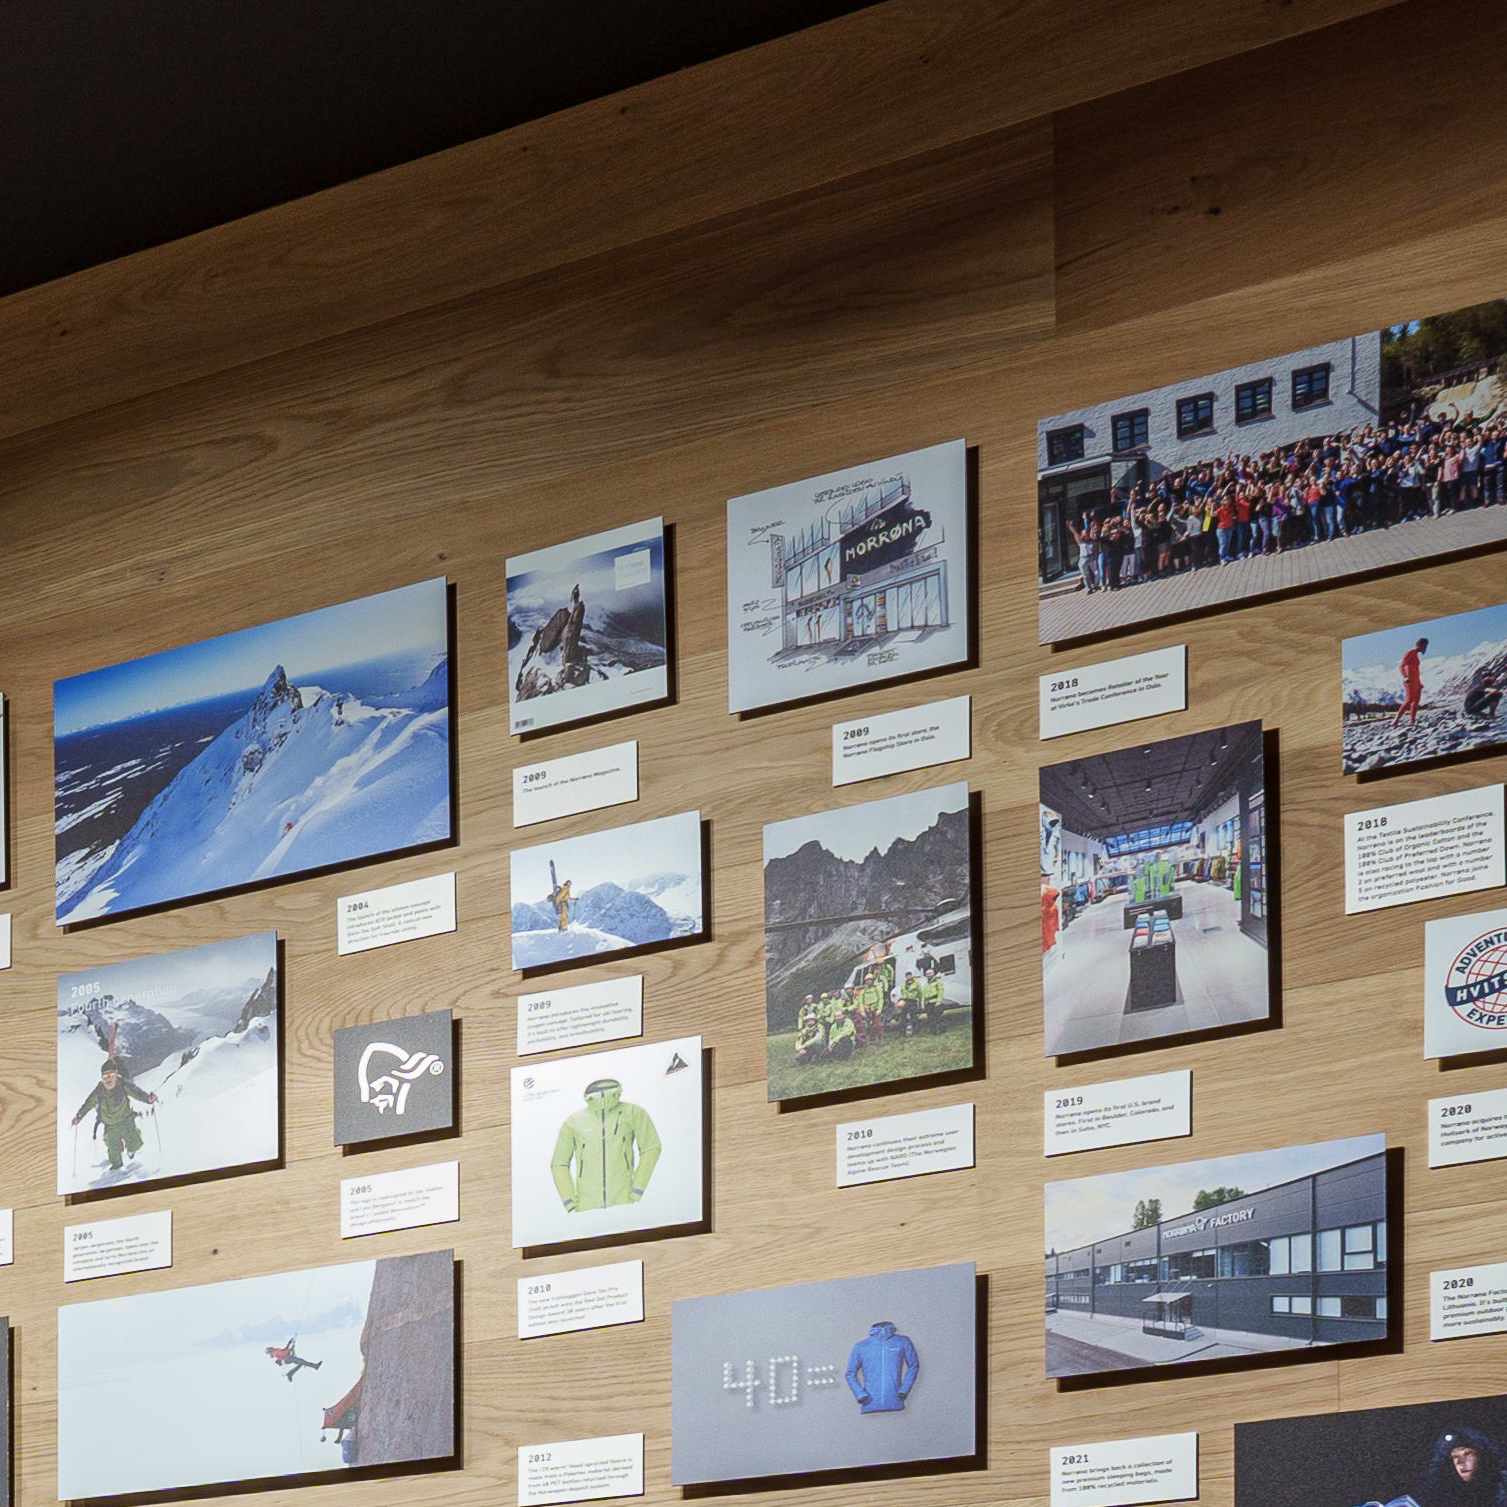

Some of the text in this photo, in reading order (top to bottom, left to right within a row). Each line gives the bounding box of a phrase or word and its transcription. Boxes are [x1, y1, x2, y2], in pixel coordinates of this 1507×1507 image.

[1050, 677, 1078, 692] 2018
[842, 725, 869, 741] 2009
[522, 770, 546, 784] 2009
[1356, 815, 1387, 831] 2018
[71, 982, 100, 998] 2005
[527, 999, 552, 1012] 2009
[1055, 1095, 1083, 1109] 2019
[1440, 1103, 1471, 1118] 2020
[846, 1128, 873, 1141] 2010
[1210, 1208, 1255, 1228] FACTORY
[527, 1283, 551, 1295] 2010
[1442, 1276, 1473, 1291] 2020
[527, 1452, 552, 1464] 2012
[1061, 1453, 1089, 1466] 2021
